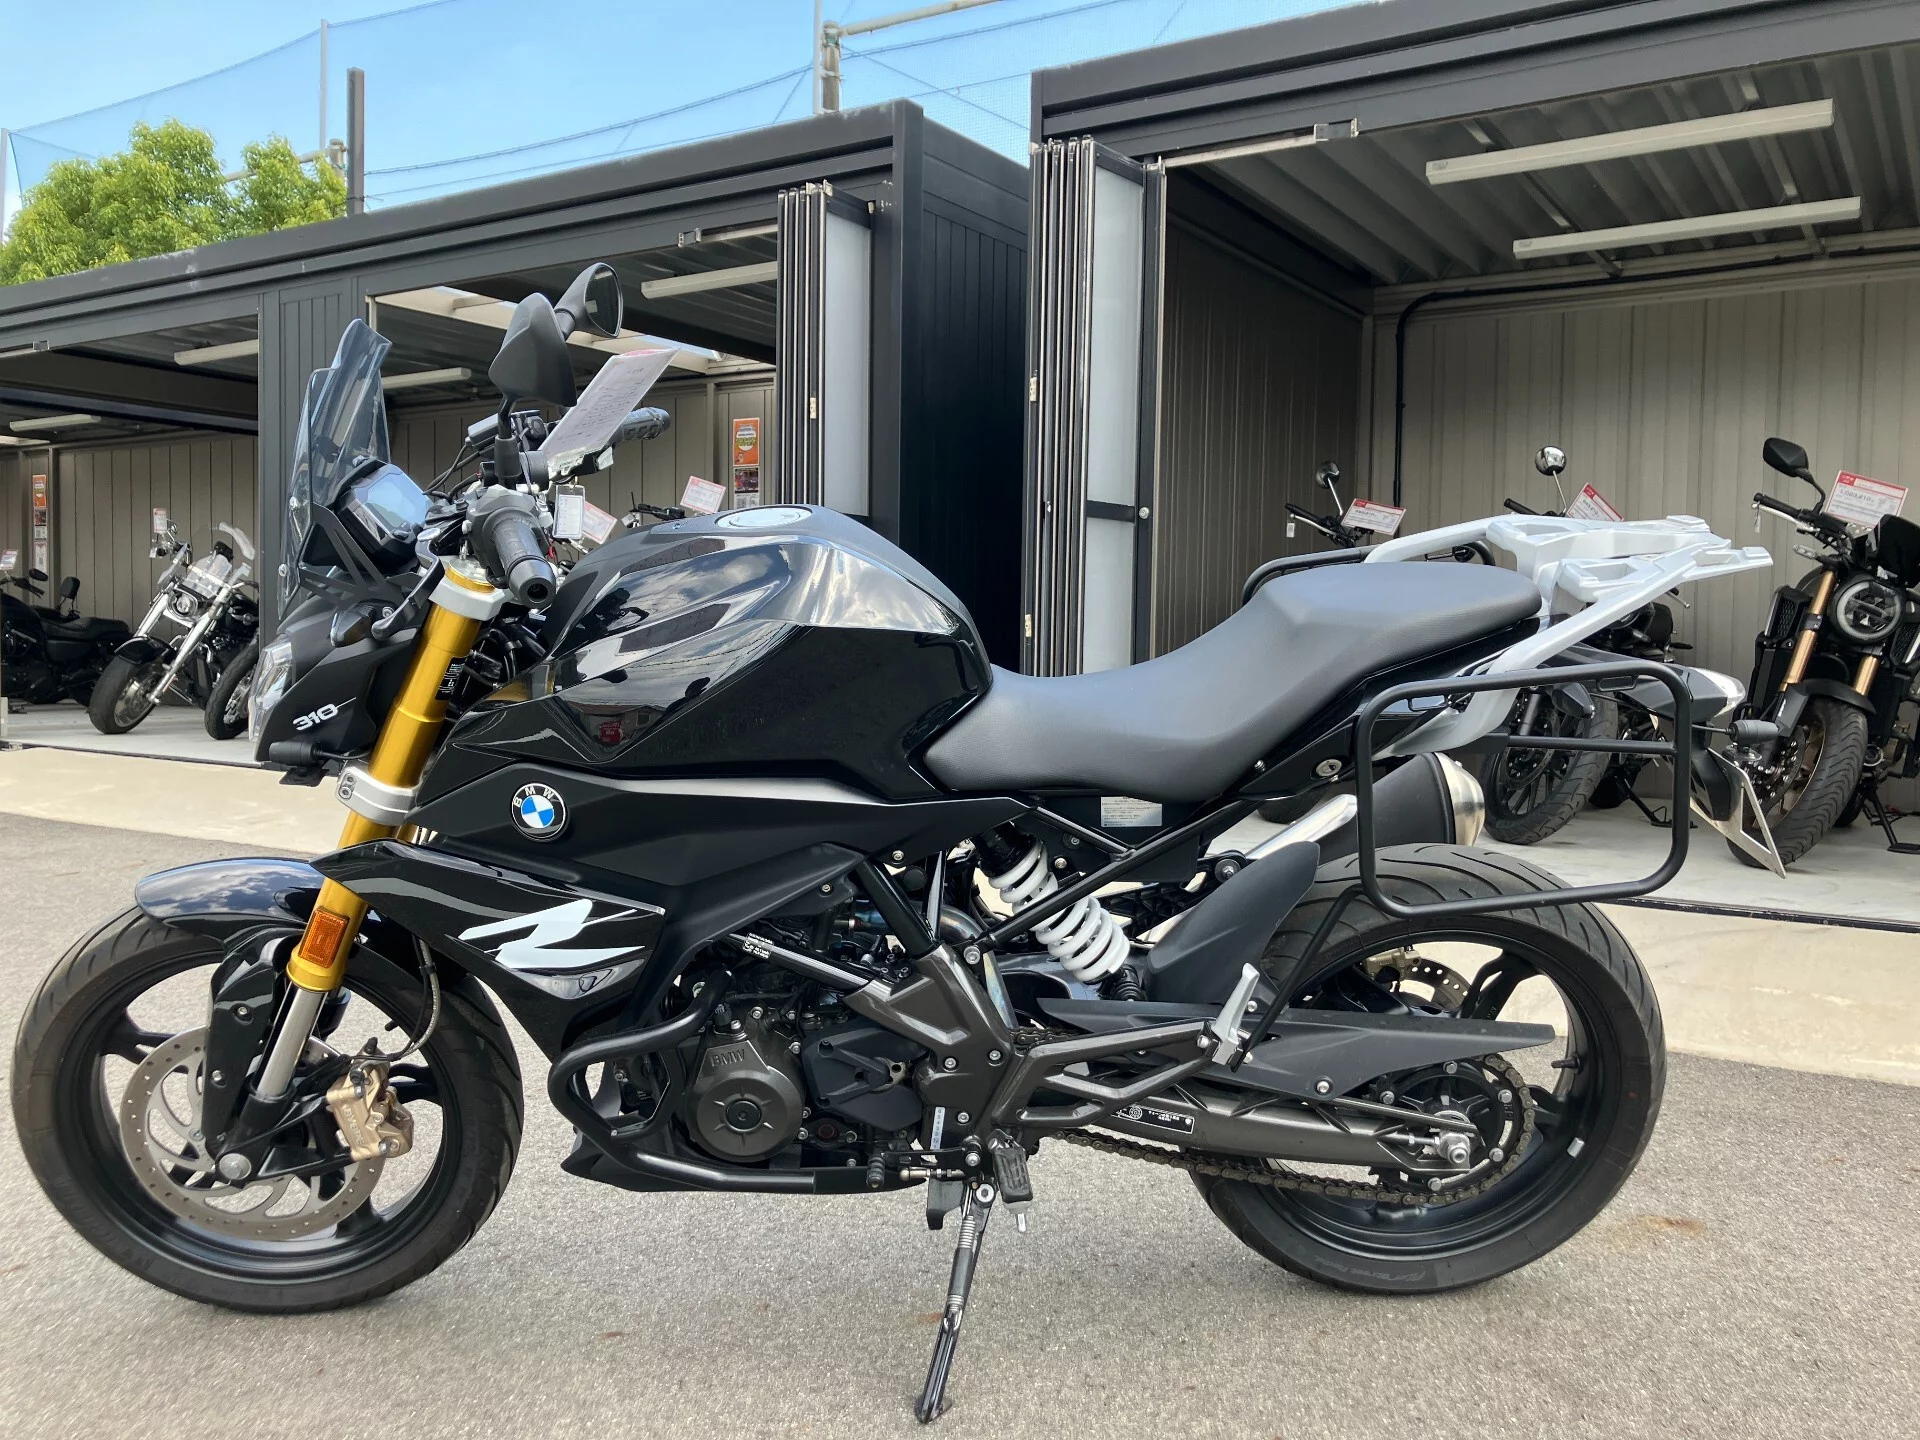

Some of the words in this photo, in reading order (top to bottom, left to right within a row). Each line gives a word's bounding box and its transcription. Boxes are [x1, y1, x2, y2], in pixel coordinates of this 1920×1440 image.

[292, 703, 339, 731] 310
[512, 785, 555, 808] BMW
[710, 1049, 746, 1068] BMW
